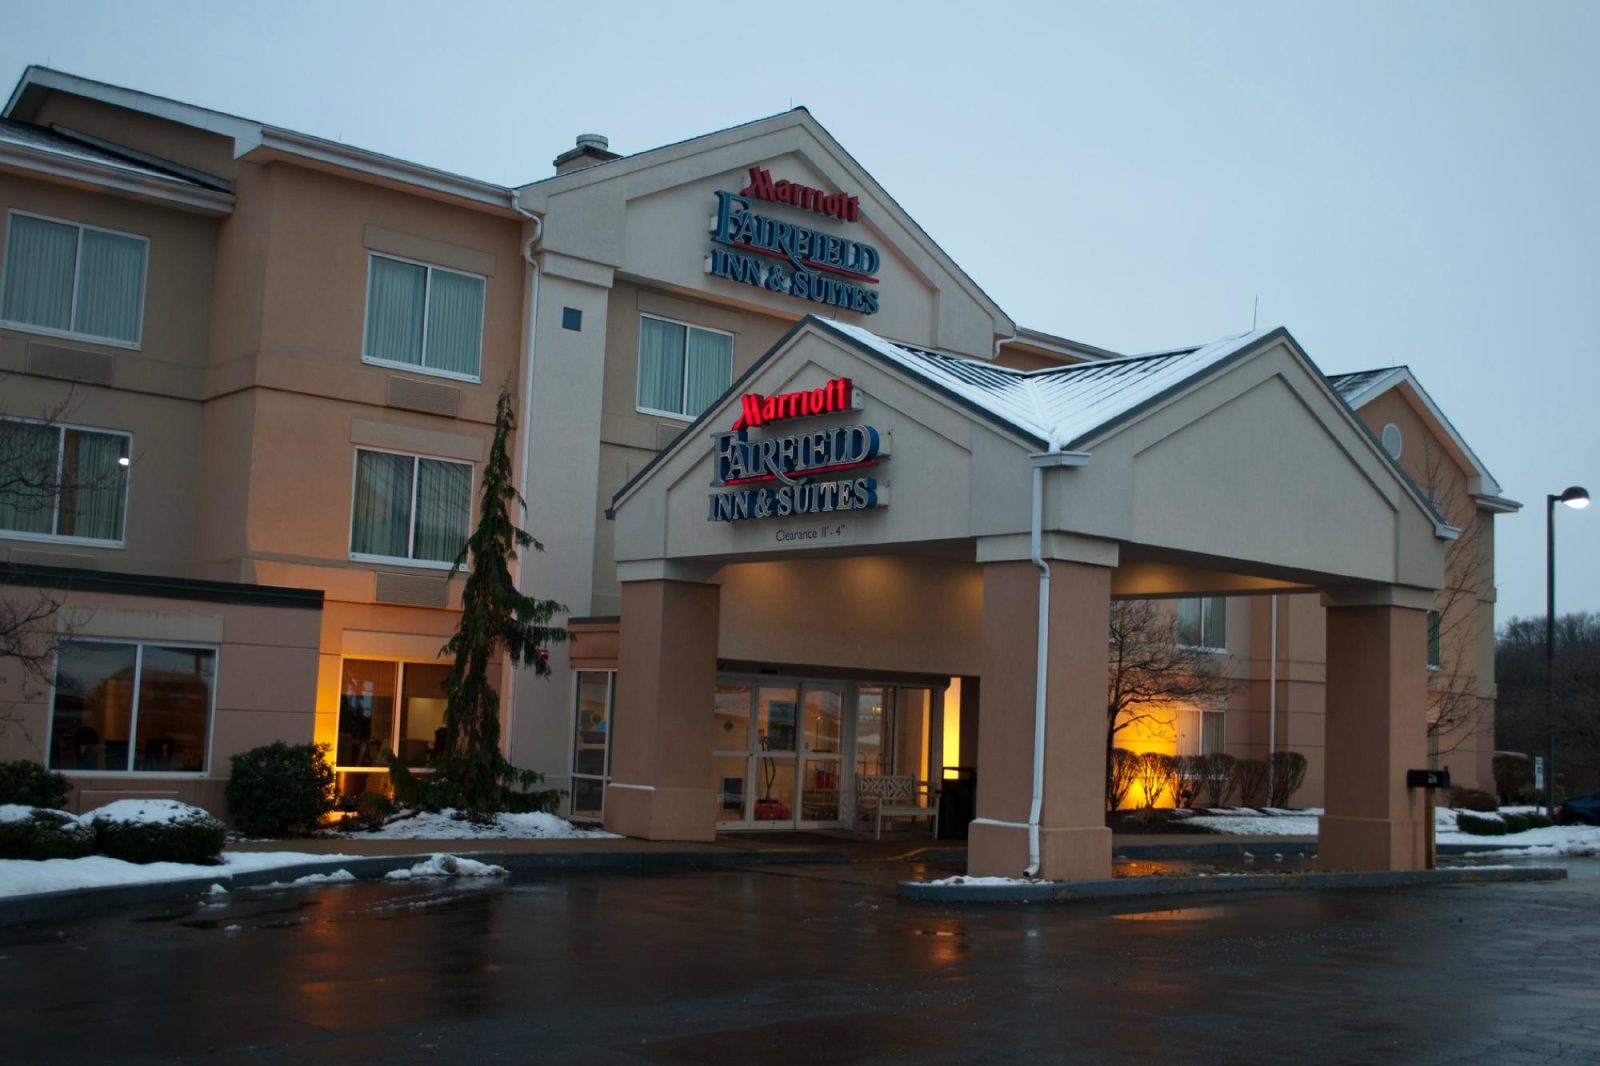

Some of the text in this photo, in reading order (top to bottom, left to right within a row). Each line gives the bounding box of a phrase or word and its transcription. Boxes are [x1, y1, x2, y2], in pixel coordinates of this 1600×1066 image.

[740, 165, 860, 223] Marriott
[711, 190, 880, 275] FAIRFIELD
[711, 248, 880, 315] INN & SUITES
[732, 377, 853, 431] Marriott
[709, 424, 878, 487] FAIRFIELD
[708, 477, 877, 522] INN & SUITES
[775, 528, 818, 542] Clearance
